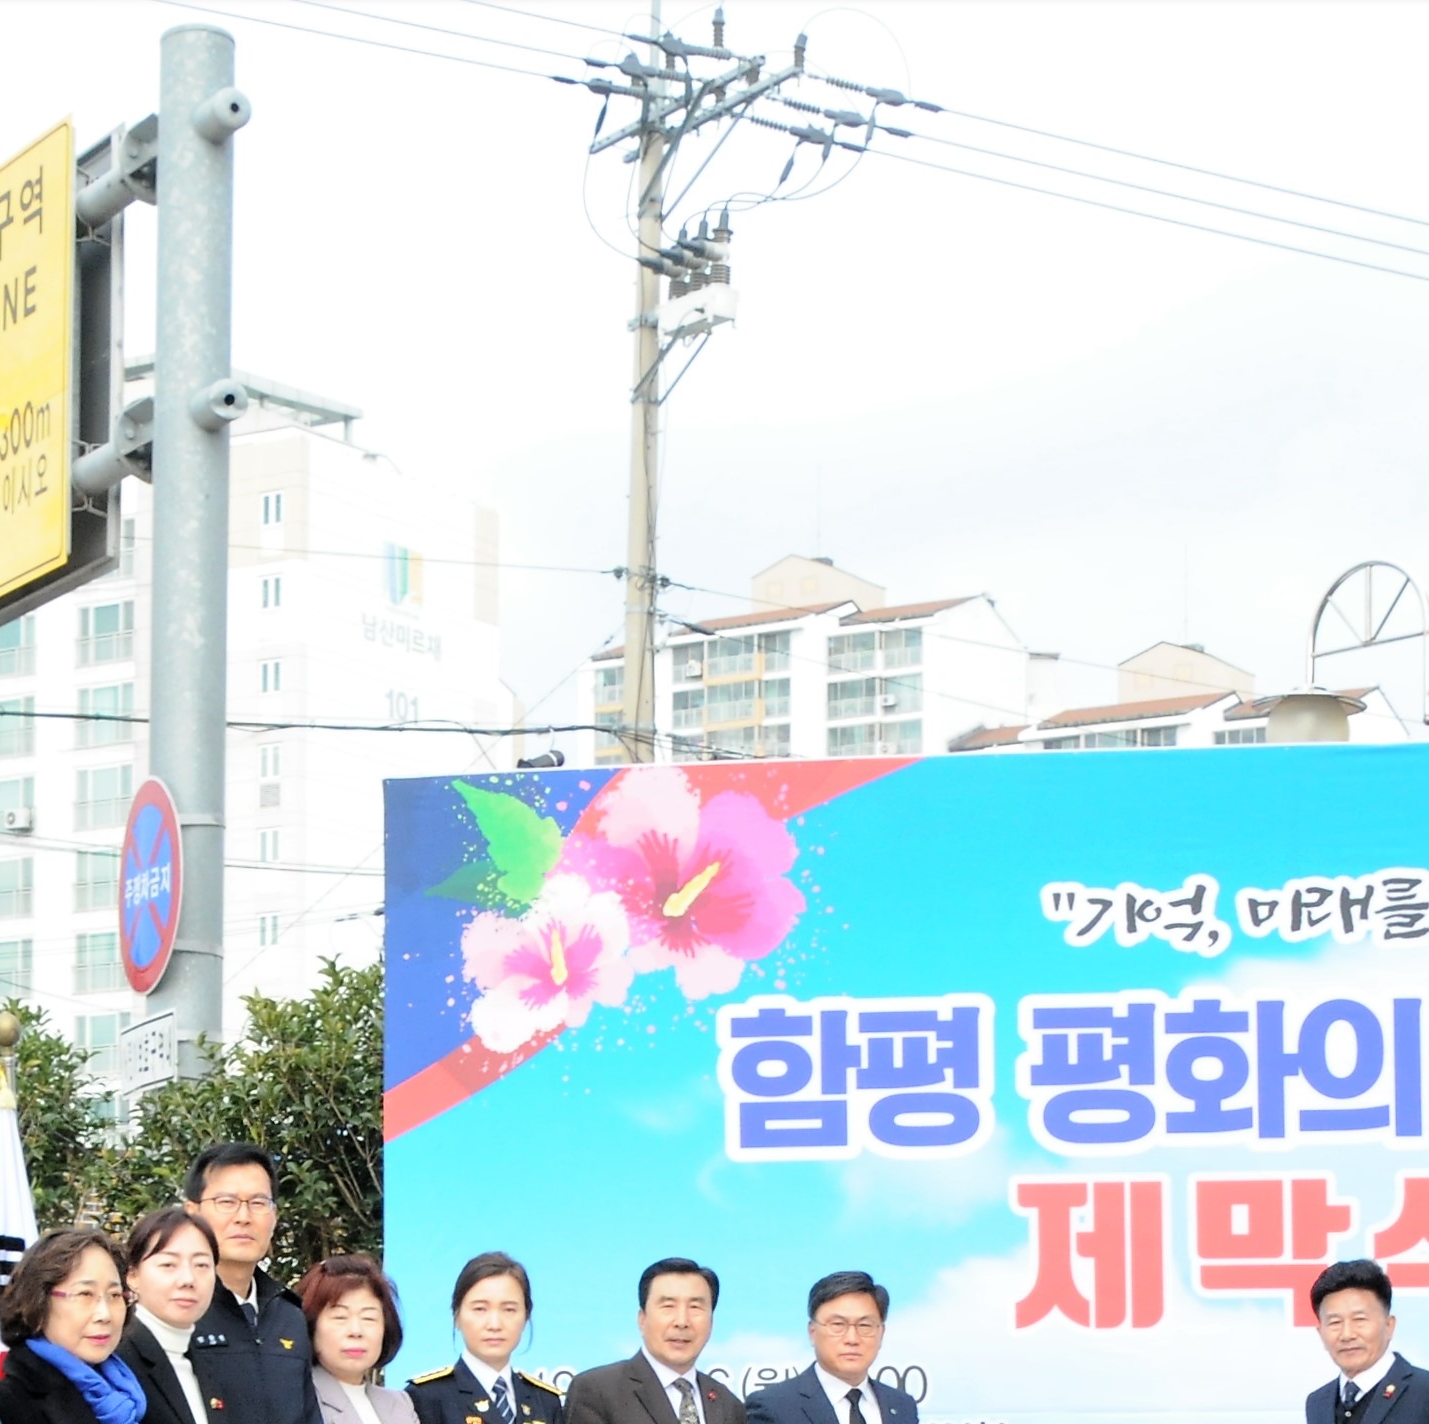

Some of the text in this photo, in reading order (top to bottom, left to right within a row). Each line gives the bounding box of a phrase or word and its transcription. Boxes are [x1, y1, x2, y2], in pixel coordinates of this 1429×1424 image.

[384, 687, 420, 726] 101
[1051, 884, 1220, 948] "기억,
[729, 1005, 981, 1149] 함평
[1029, 999, 1422, 1147] 평화의
